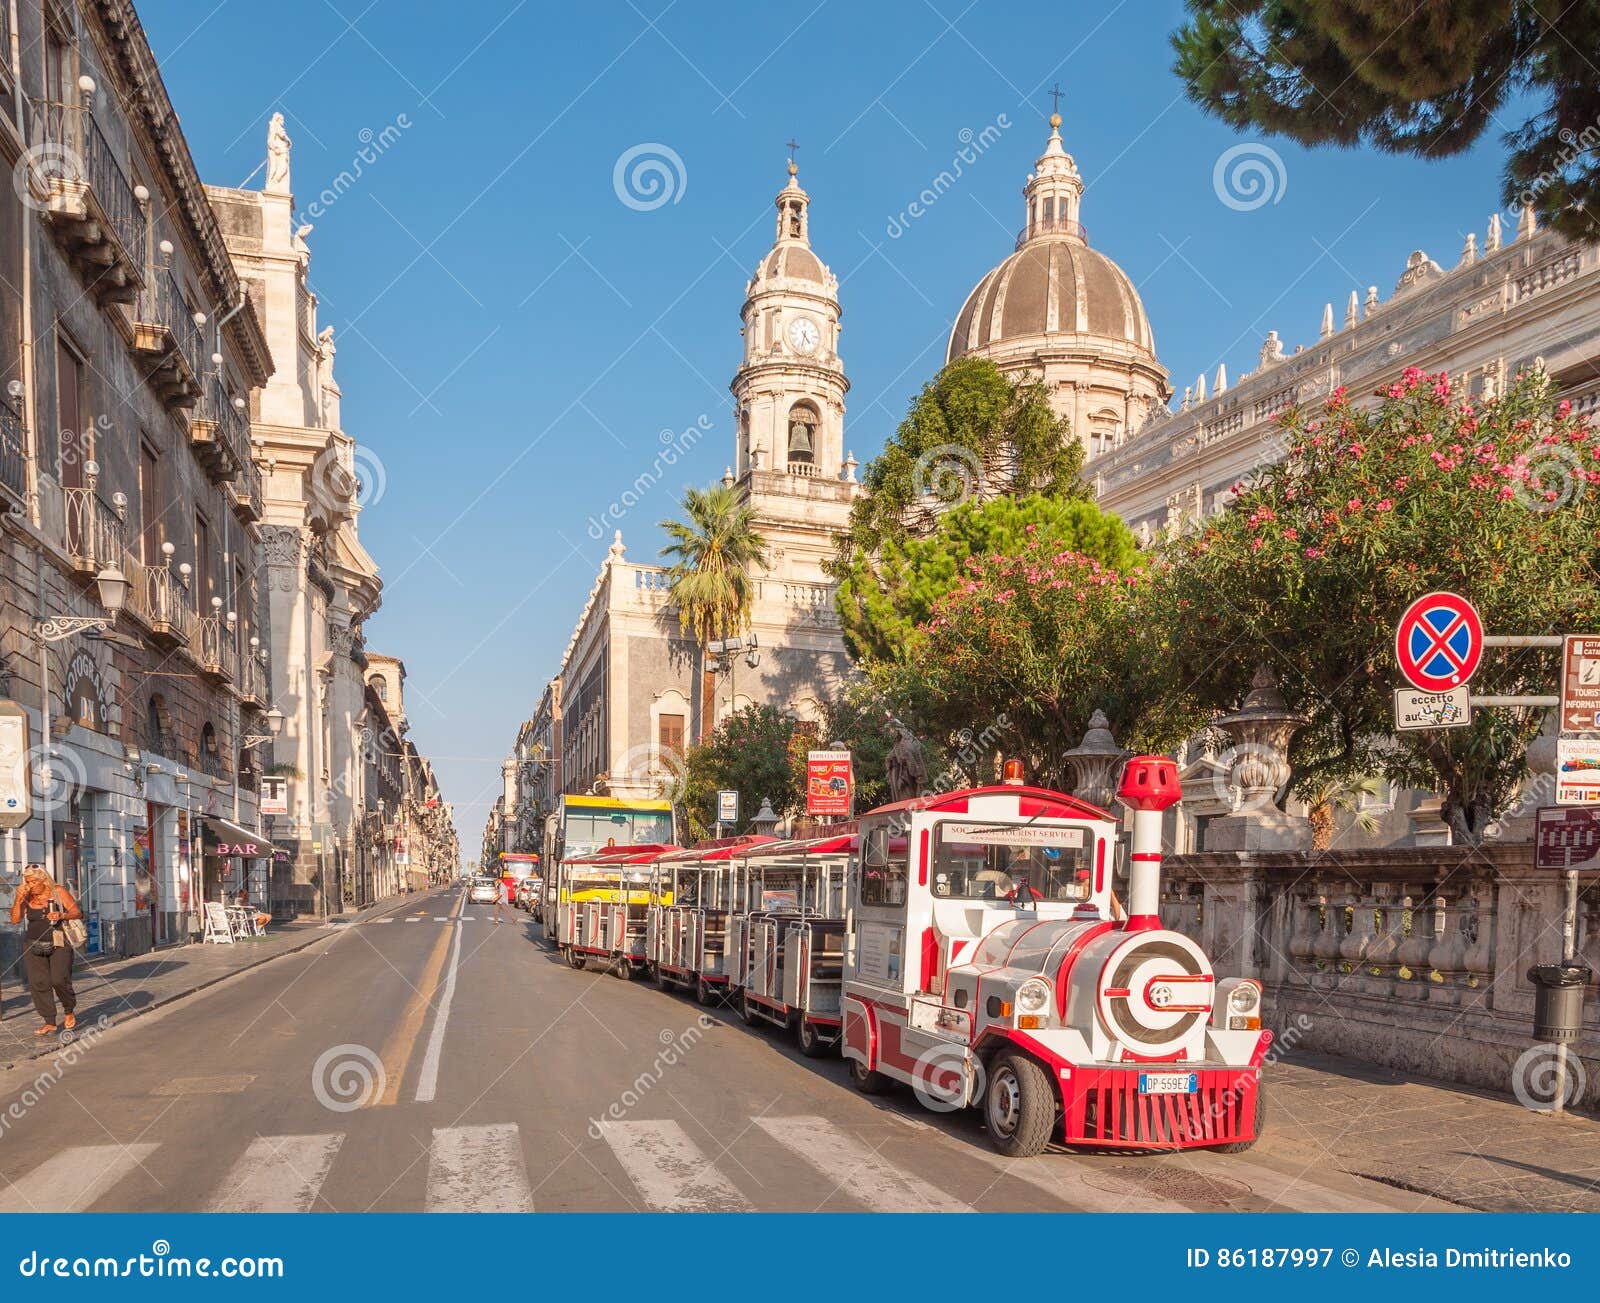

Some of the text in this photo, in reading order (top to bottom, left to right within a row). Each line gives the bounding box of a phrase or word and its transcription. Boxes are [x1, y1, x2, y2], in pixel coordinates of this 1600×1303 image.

[1411, 693, 1454, 705] eccetto
[1038, 831, 1075, 839] SERVICE
[216, 843, 259, 855] BAR
